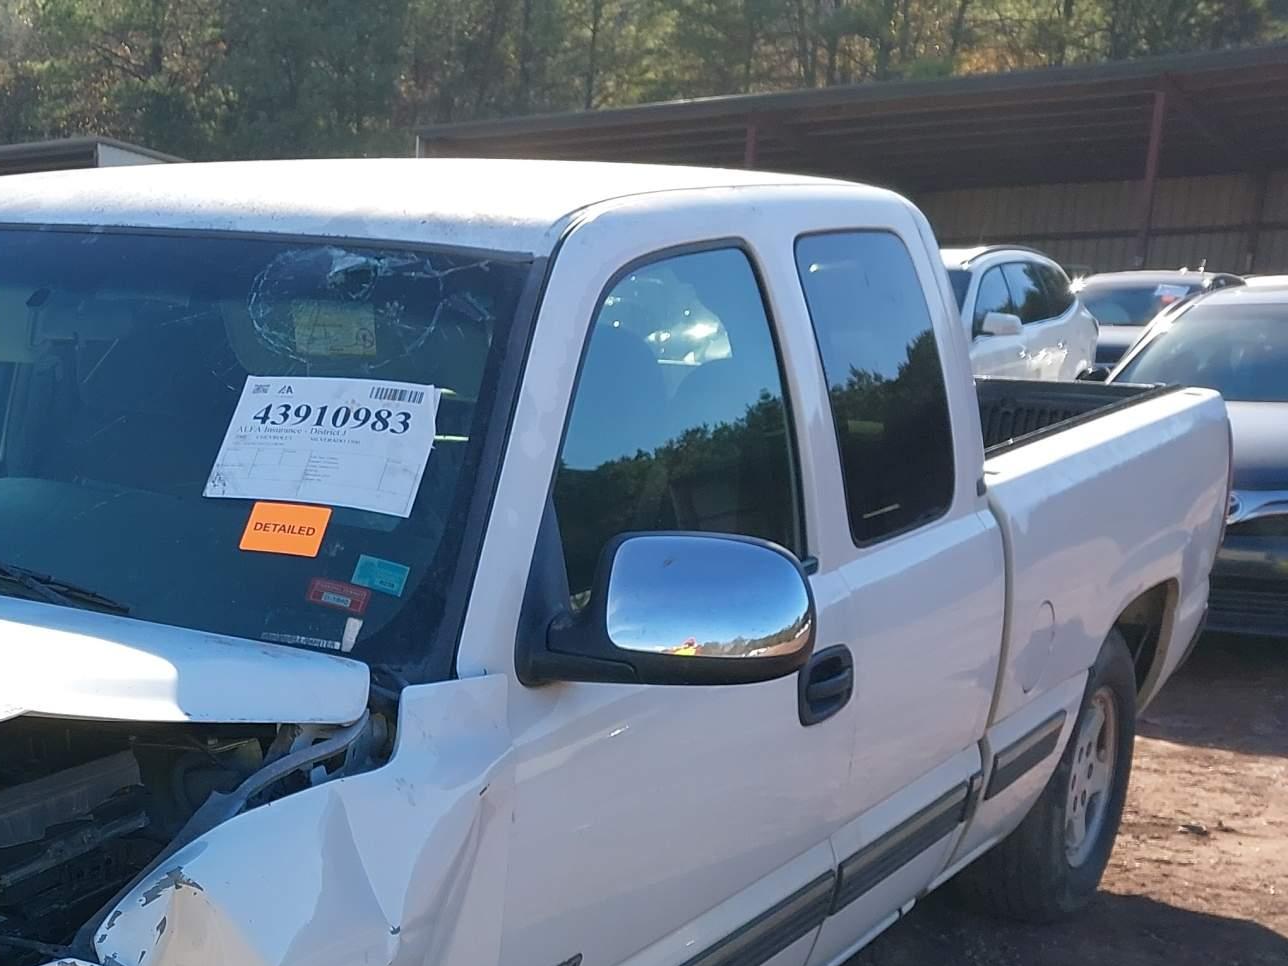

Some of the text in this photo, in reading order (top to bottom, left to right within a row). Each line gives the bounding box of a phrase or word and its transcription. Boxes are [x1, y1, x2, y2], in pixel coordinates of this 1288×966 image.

[253, 403, 412, 434] 43910983
[263, 426, 302, 435] Insurance
[309, 427, 341, 437] District
[253, 522, 316, 537] DETAILED
